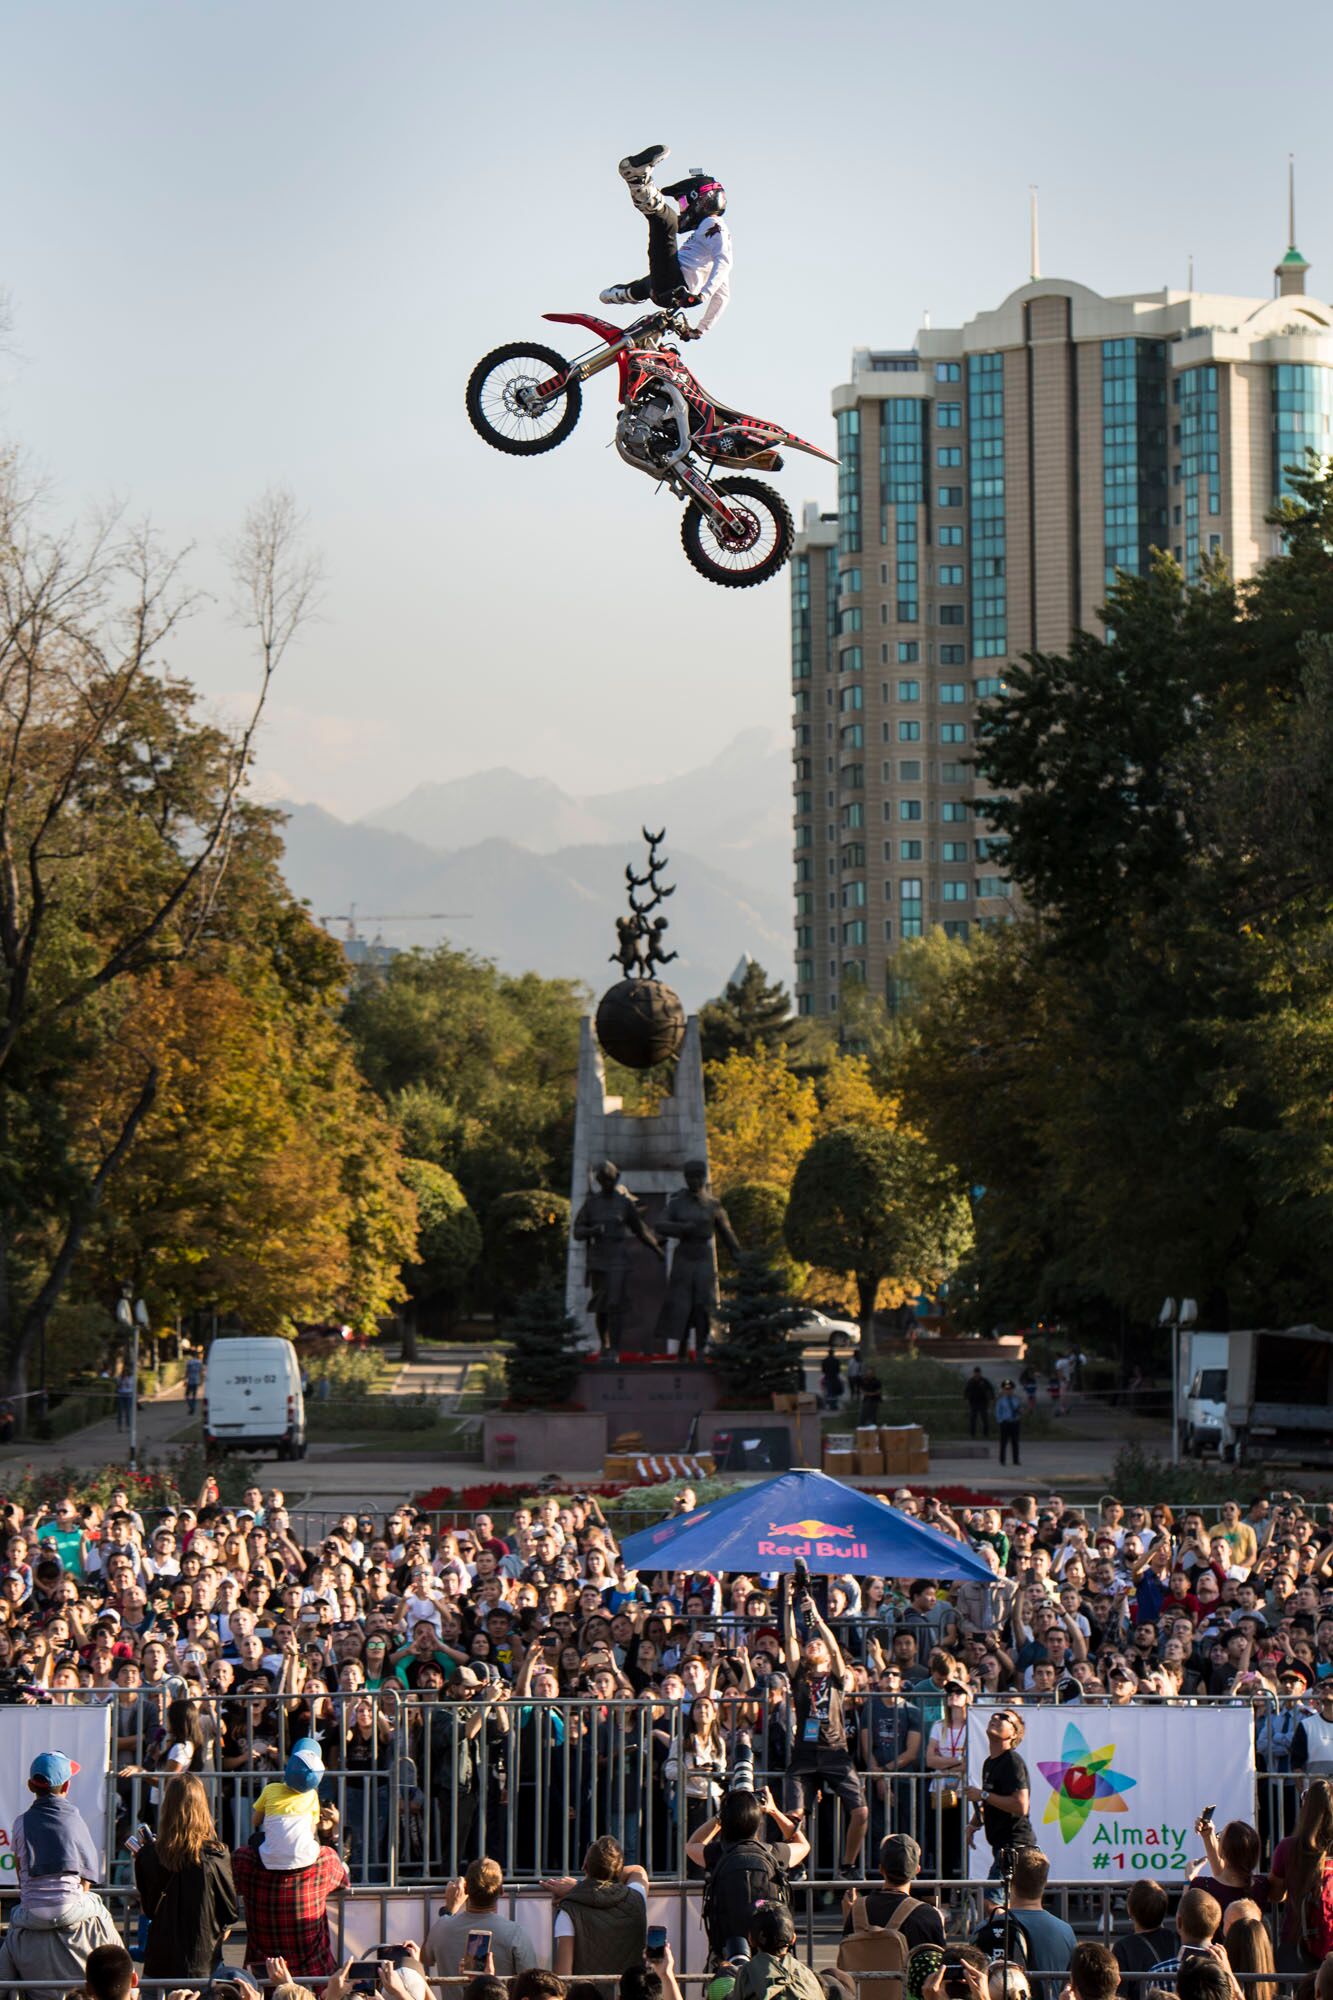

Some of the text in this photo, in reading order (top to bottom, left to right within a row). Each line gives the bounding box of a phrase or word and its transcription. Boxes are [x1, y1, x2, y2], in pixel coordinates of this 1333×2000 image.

[758, 1541, 867, 1558] Red Bull
[1092, 1821, 1187, 1851] Almaty
[1092, 1852, 1187, 1870] #1002
